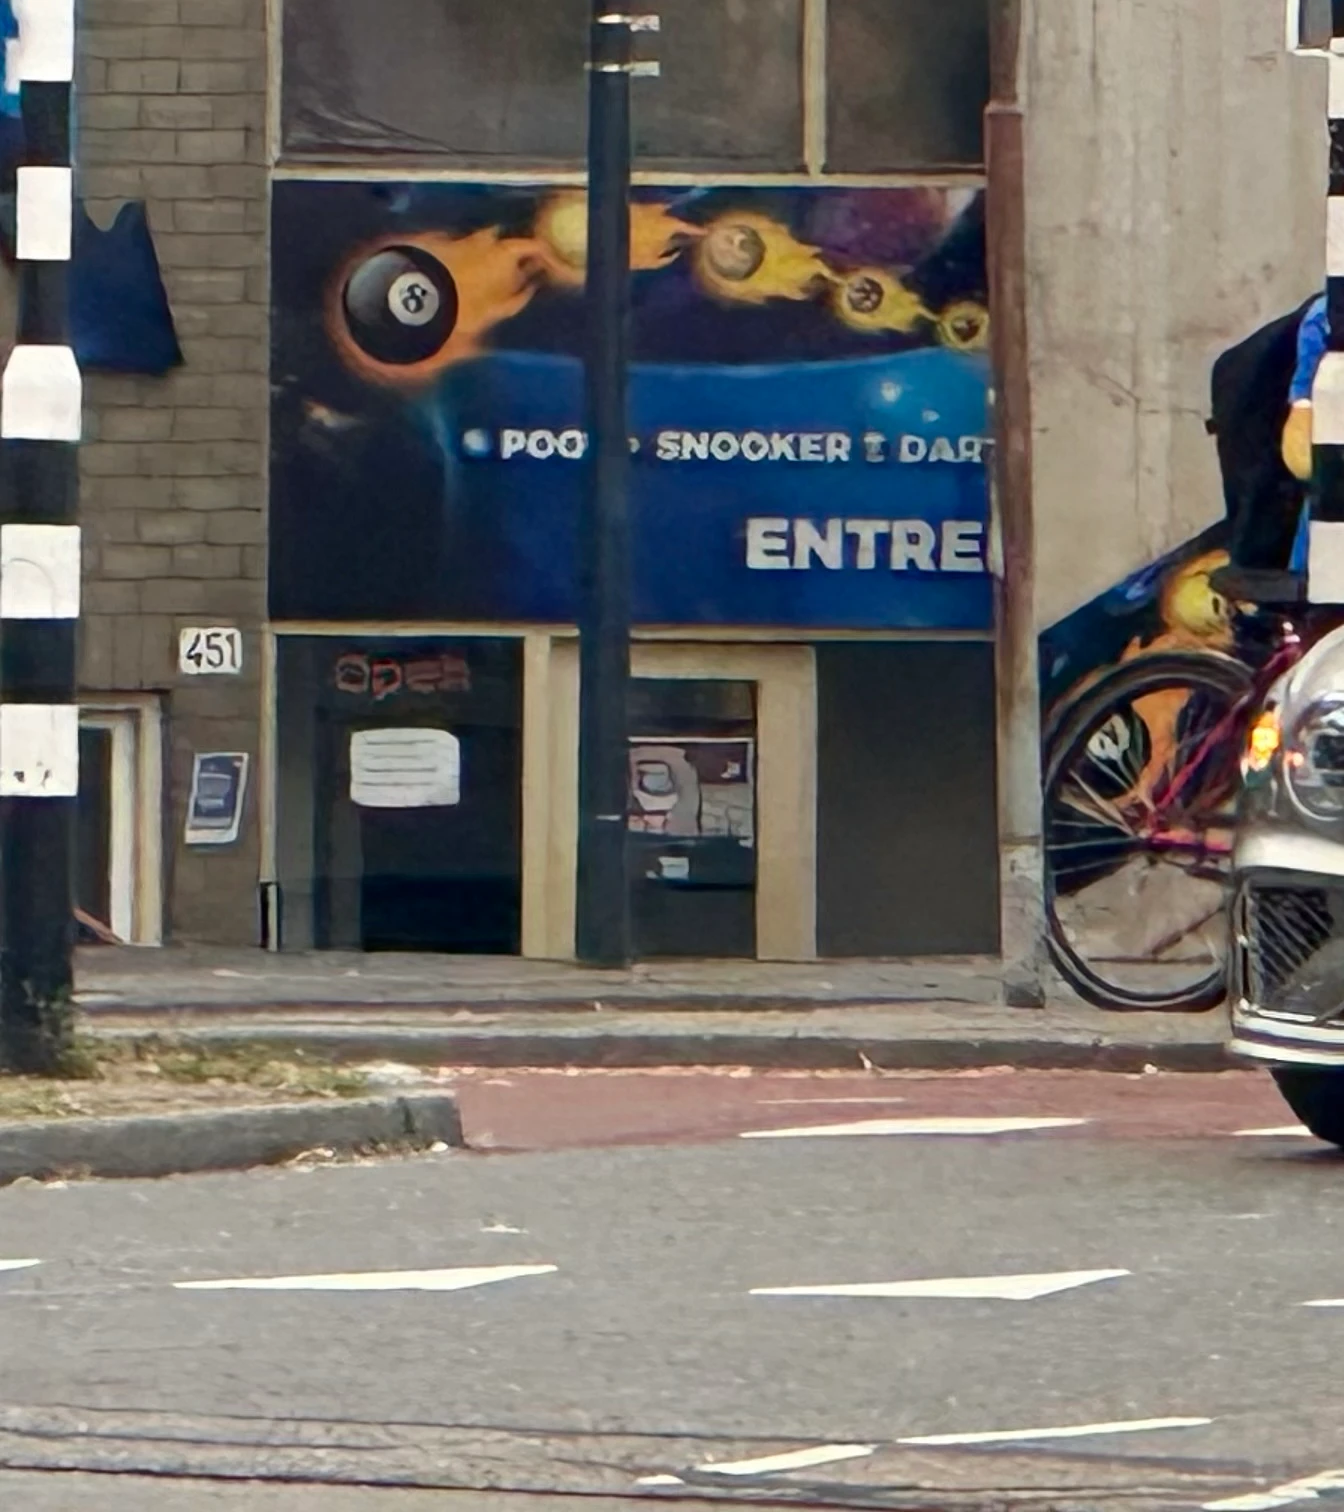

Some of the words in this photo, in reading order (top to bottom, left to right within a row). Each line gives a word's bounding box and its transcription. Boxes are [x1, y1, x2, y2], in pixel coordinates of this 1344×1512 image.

[501, 429, 588, 459] POO
[656, 431, 851, 462] SNOOKER
[746, 517, 986, 572] ENTRE
[186, 633, 237, 668] 451
